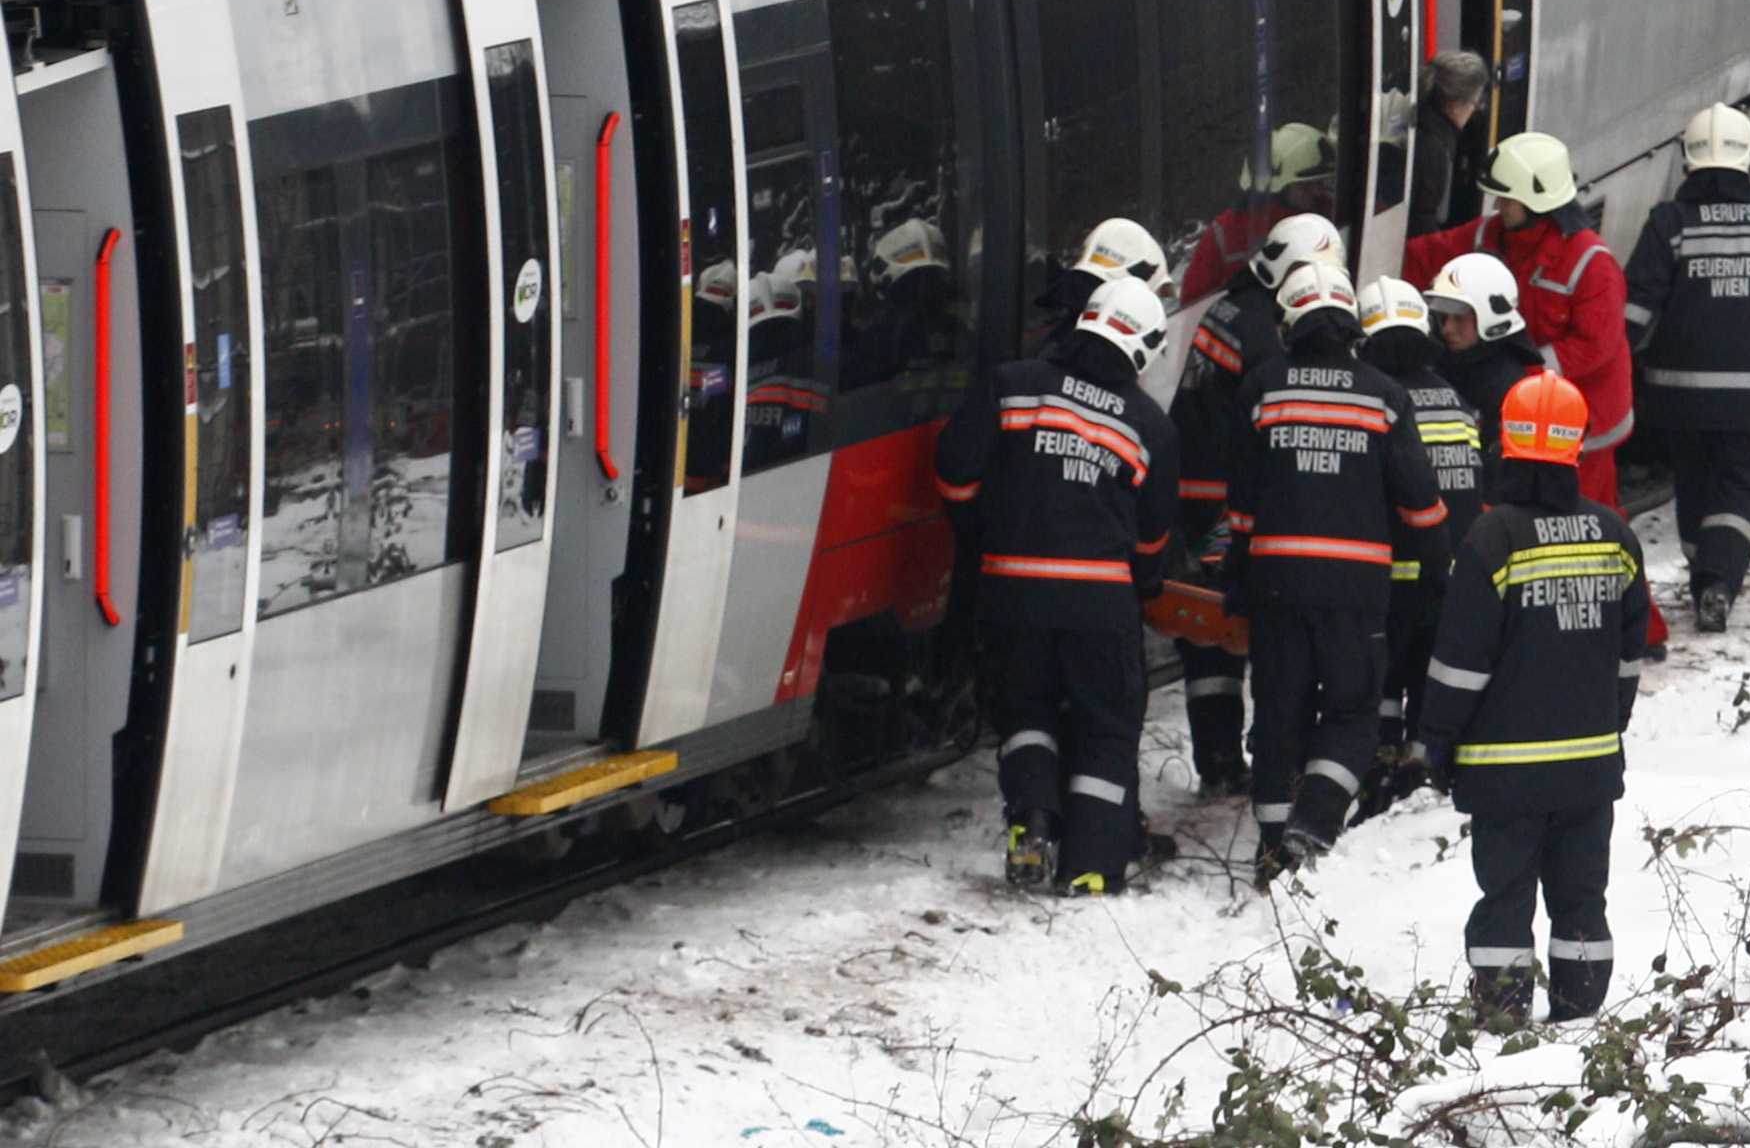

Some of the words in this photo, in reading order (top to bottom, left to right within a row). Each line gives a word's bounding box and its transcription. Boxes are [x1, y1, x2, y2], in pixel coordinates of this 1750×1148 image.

[1711, 278, 1750, 297] WIEN
[1287, 367, 1353, 388] BERUFS
[1061, 375, 1127, 416] BERUFS
[1270, 426, 1368, 454] FEUERWEHR
[1296, 450, 1341, 475] WIEN
[1437, 467, 1475, 489] WIEN
[1534, 514, 1603, 543] BERUFS
[1556, 603, 1602, 631] WIEN
